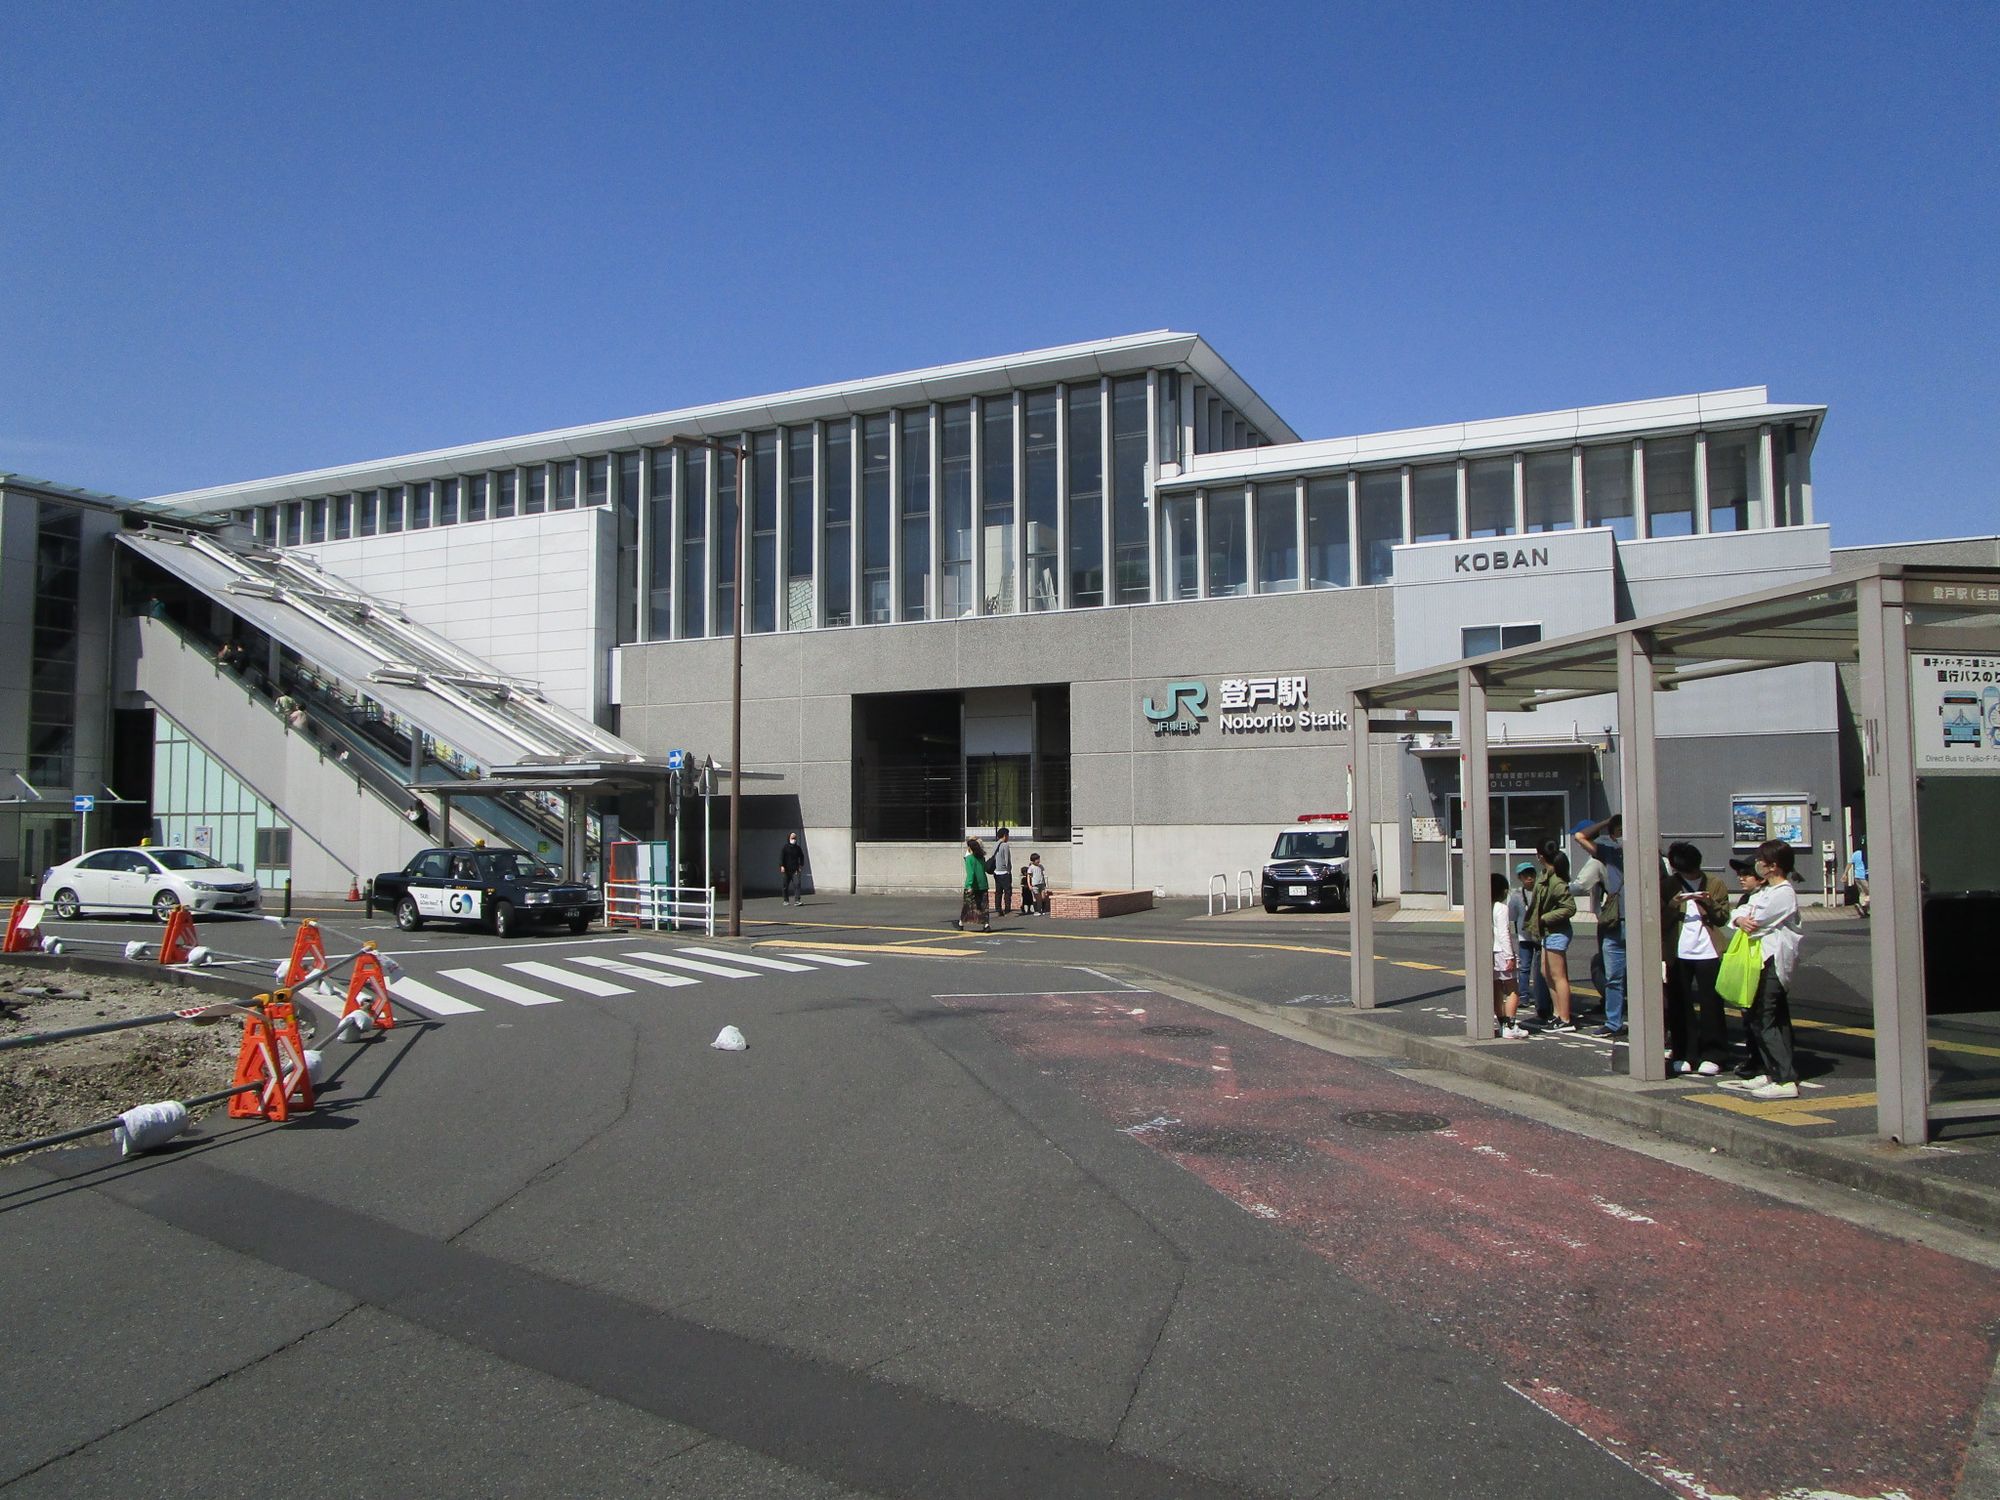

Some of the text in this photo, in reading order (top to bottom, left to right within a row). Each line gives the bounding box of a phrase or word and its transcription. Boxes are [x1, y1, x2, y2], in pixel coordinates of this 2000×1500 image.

[1455, 547, 1548, 572] KOBAN
[1143, 681, 1207, 719] JR
[1220, 676, 1307, 708] 登戸駅
[1152, 720, 1199, 732] JR東日本
[1220, 709, 1348, 730] Noborito Statio
[1490, 780, 1530, 788] OLICE
[449, 893, 473, 914] GO
